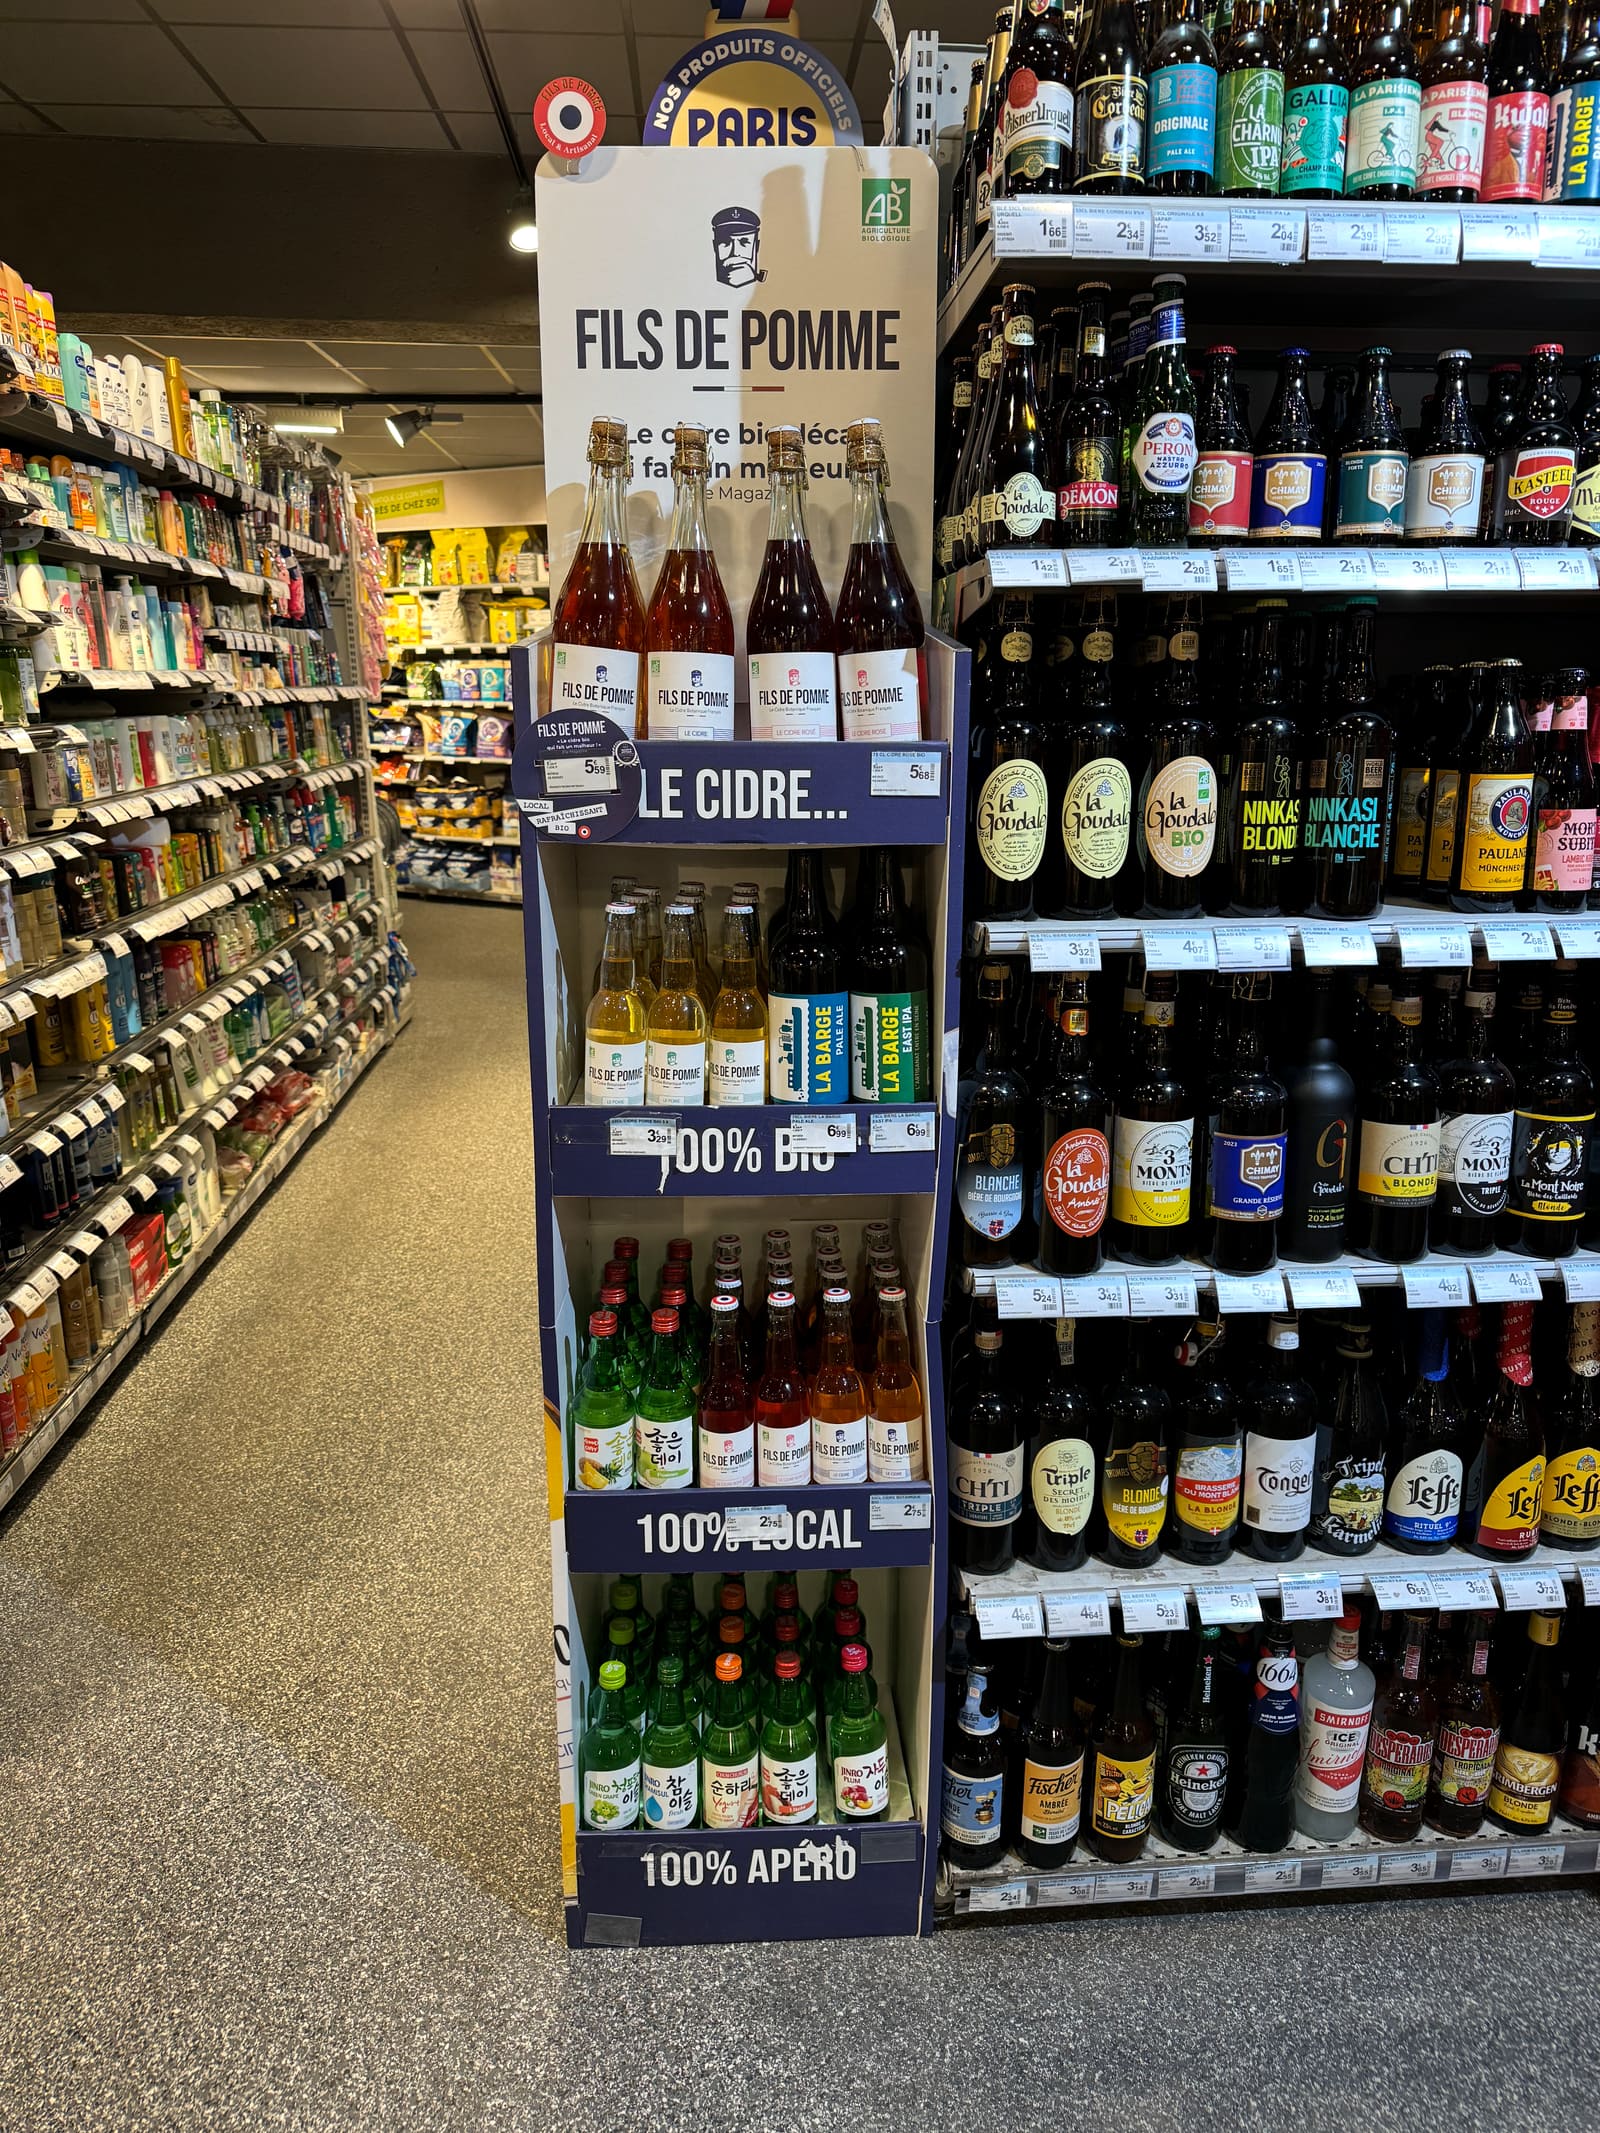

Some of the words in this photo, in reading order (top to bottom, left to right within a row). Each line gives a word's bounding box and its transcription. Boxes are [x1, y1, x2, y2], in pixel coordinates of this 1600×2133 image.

[652, 86, 681, 131] NOS
[679, 38, 775, 85] PRODUITS
[780, 44, 852, 132] OFFICIELS
[1290, 89, 1347, 108] GALLIA
[1355, 92, 1366, 101] LA
[1249, 104, 1264, 121] LA
[688, 107, 816, 147] PARIS
[1005, 110, 1037, 143] Pilsner
[1154, 116, 1209, 134] ORIGINALE
[1571, 95, 1595, 157] BARGE
[540, 122, 557, 146] Local
[563, 133, 598, 154] Artisanal
[1568, 161, 1588, 185] LA
[576, 309, 663, 370] FILS
[675, 309, 729, 370] DE
[741, 309, 900, 370] POMME
[1194, 484, 1230, 493] CHIMAY
[1270, 485, 1306, 495] CHIMAY
[1434, 486, 1470, 496] CHIMAY
[1513, 469, 1571, 496] KASTEEL
[1530, 497, 1560, 505] ROUGE
[563, 682, 581, 699] FILS
[585, 684, 598, 700] DE
[601, 687, 634, 705] POMME
[659, 690, 677, 705] FILS
[681, 691, 694, 705] DE
[697, 691, 729, 708] POMME
[759, 690, 777, 705] FILS
[780, 690, 793, 704] DE
[796, 689, 829, 704] POMME
[852, 691, 863, 705] DE
[865, 687, 903, 704] POMME
[537, 723, 557, 737] FILS
[559, 722, 570, 736] DE
[572, 721, 606, 735] POMME
[1365, 767, 1383, 775] BEER
[639, 768, 684, 819] LE
[695, 768, 848, 820] CIDRE...
[1086, 792, 1106, 812] la
[1170, 791, 1187, 811] la
[523, 802, 549, 810] LOCAL
[1000, 794, 1019, 813] la
[1308, 798, 1378, 821] NINKASI
[978, 801, 1046, 840] Goudale
[1145, 800, 1216, 837] Goudale
[1171, 829, 1204, 847] BIO
[1304, 824, 1380, 848] BLANCHE
[836, 1004, 844, 1027] ALE
[902, 1006, 912, 1024] IPA
[816, 1006, 832, 1066] BARGE
[836, 1031, 844, 1056] PALE
[881, 1007, 899, 1065] BARGE
[902, 1027, 912, 1053] EAST
[589, 1067, 602, 1080] FILS
[604, 1070, 615, 1081] DE
[617, 1067, 643, 1081] POMME
[661, 1068, 670, 1079] DE
[672, 1067, 700, 1079] POMME
[720, 1065, 729, 1077] DE
[731, 1065, 760, 1078] POMME
[816, 1072, 832, 1093] LA
[882, 1070, 899, 1092] LA
[1163, 1149, 1175, 1165] 3
[1490, 1141, 1500, 1156] 3
[1246, 1164, 1279, 1175] CHIMAY
[976, 1174, 1020, 1191] BLANCHE
[1393, 1177, 1434, 1187] BLONDE
[1531, 1180, 1559, 1193] Mont
[763, 1449, 778, 1461] FILS
[780, 1451, 790, 1461] DE
[815, 1441, 828, 1455] FILS
[830, 1444, 840, 1456] DE
[841, 1440, 865, 1456] POMME
[884, 1443, 893, 1455] DE
[895, 1440, 919, 1455] POMME
[703, 1451, 716, 1465] FILS
[718, 1455, 728, 1466] DE
[1041, 1465, 1090, 1488] Triple
[1052, 1487, 1085, 1496] SECRET
[1123, 1486, 1160, 1503] BLONDE
[1184, 1488, 1197, 1496] DU
[1198, 1489, 1221, 1499] MONT
[1194, 1481, 1236, 1491] BRASSERIE
[1406, 1474, 1460, 1516] Leffe
[962, 1503, 1001, 1512] TRIPLE
[1188, 1503, 1200, 1513] LA
[1204, 1502, 1237, 1514] BLONDE
[1414, 1522, 1443, 1530] RITUEL
[1203, 1666, 1211, 1703] Heineken
[1319, 1712, 1369, 1728] SMIRNOFF
[1325, 1740, 1360, 1750] ORIGINAL
[1333, 1733, 1356, 1742] ICE
[1176, 1754, 1204, 1769] HEINEKEN
[841, 1766, 863, 1777] JINRO
[1170, 1769, 1228, 1791] Heineken
[589, 1780, 610, 1793] JINRO
[1028, 1766, 1079, 1795] Fischer
[1040, 1798, 1068, 1809] AMBRÉE
[1188, 1810, 1207, 1819] MALT
[1208, 1797, 1223, 1817] LAGER
[1503, 1796, 1539, 1810] BLONDE
[641, 1850, 737, 1887] 100%
